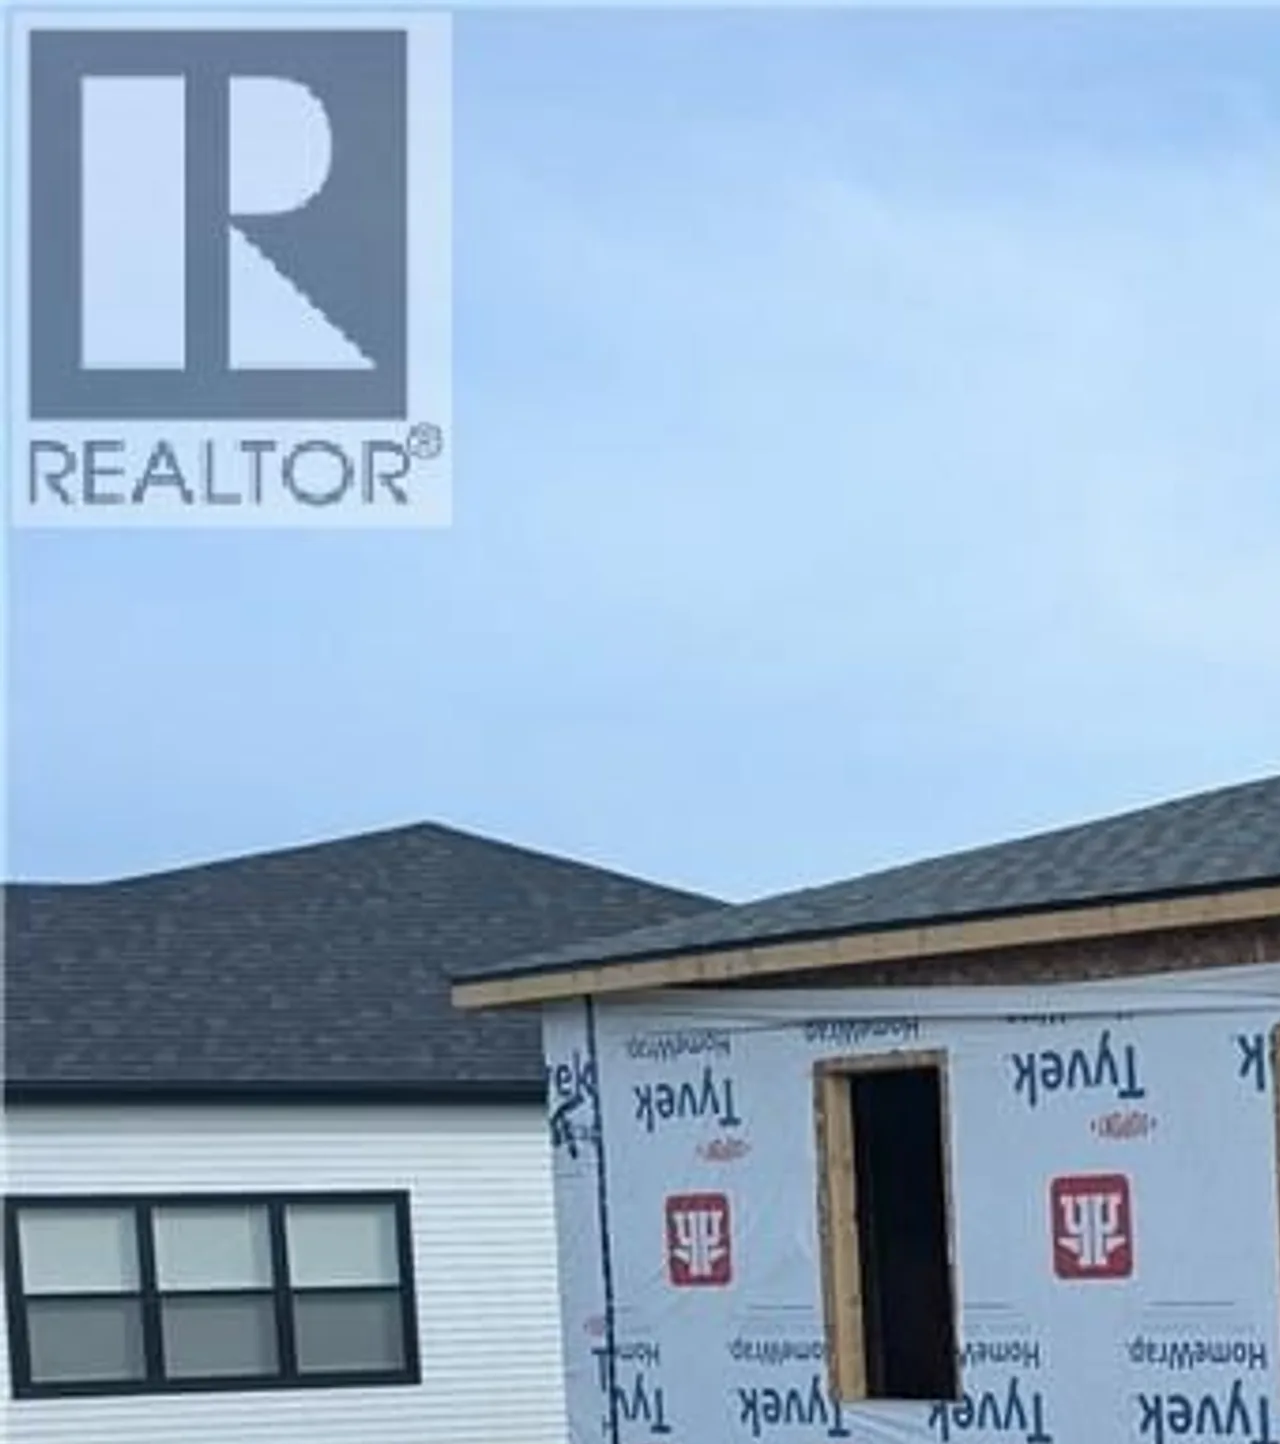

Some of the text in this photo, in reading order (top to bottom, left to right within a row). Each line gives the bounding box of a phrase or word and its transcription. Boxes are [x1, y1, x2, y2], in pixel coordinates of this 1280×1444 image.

[634, 1066, 742, 1133] Tyvek
[1011, 1030, 1145, 1107] Tyvek
[727, 1338, 824, 1367] omeWrap
[1129, 1336, 1267, 1370] HomeWrap
[738, 1373, 851, 1438] Tyvek
